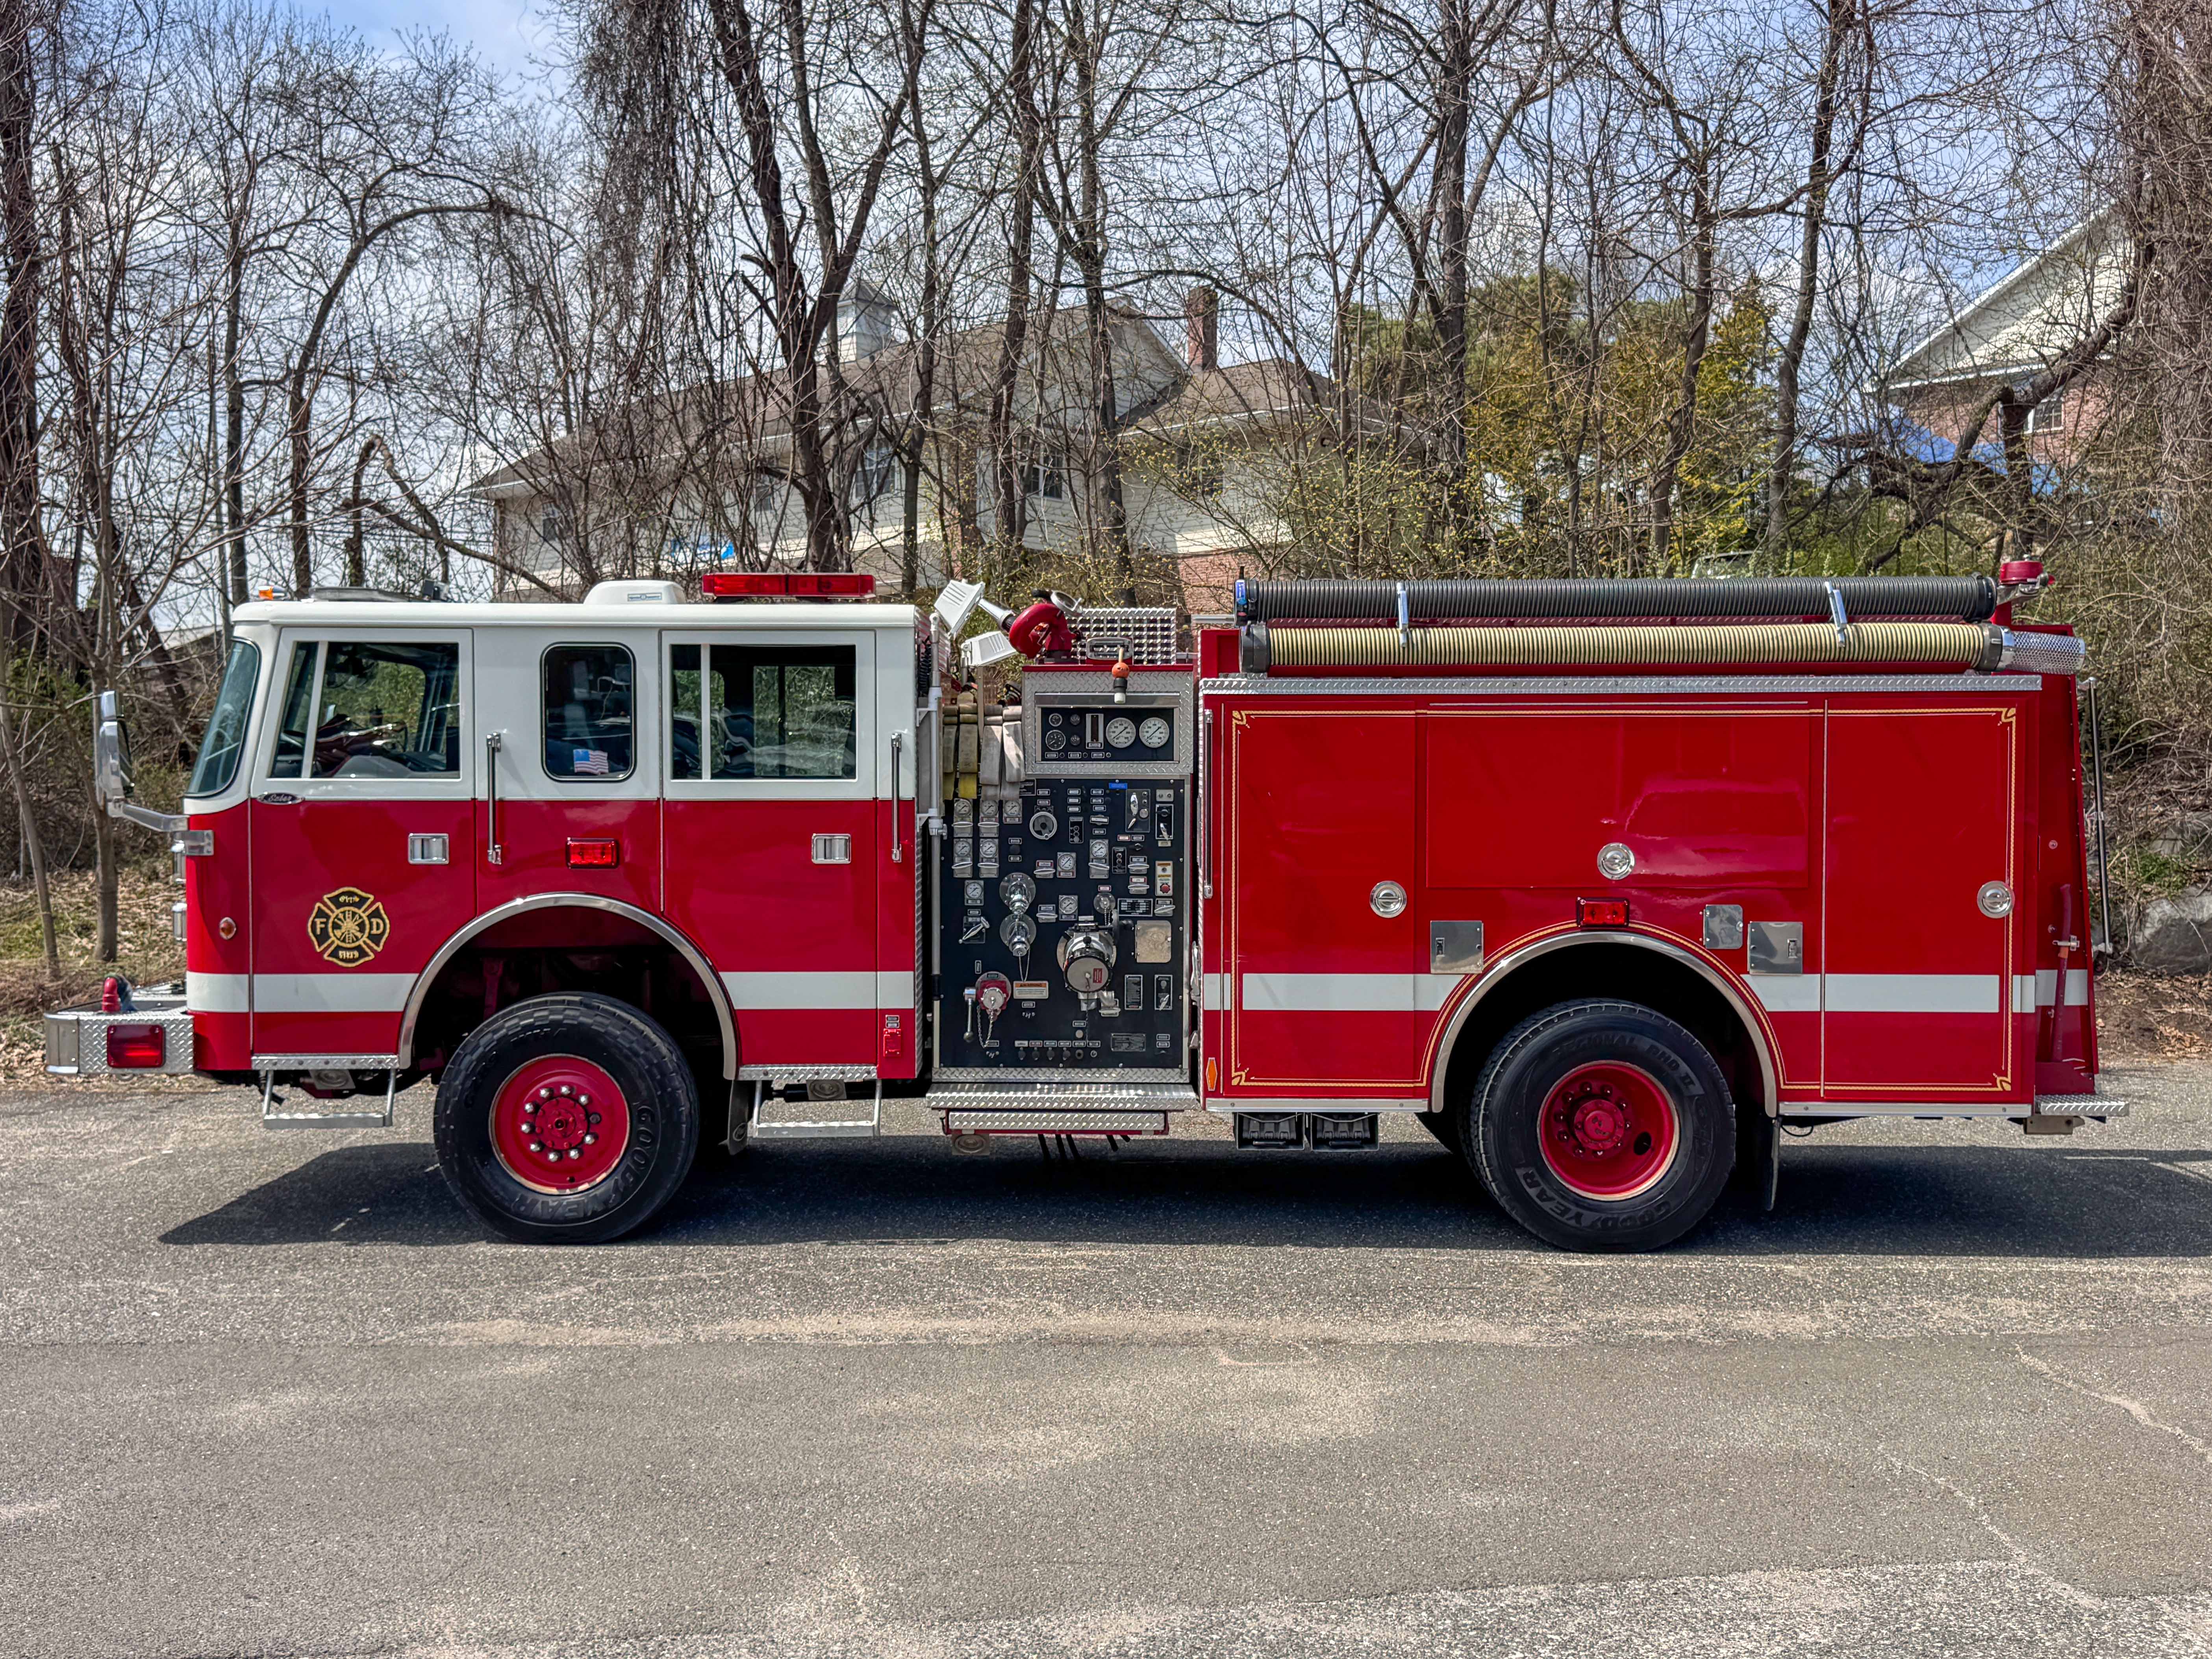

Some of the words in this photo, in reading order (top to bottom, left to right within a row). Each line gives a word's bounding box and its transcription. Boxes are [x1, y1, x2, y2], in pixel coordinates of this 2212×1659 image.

[315, 918, 326, 935] F
[370, 918, 384, 934] D
[512, 1105, 655, 1220] GOODYEAR
[1522, 1170, 1671, 1230] GOODYEAR
